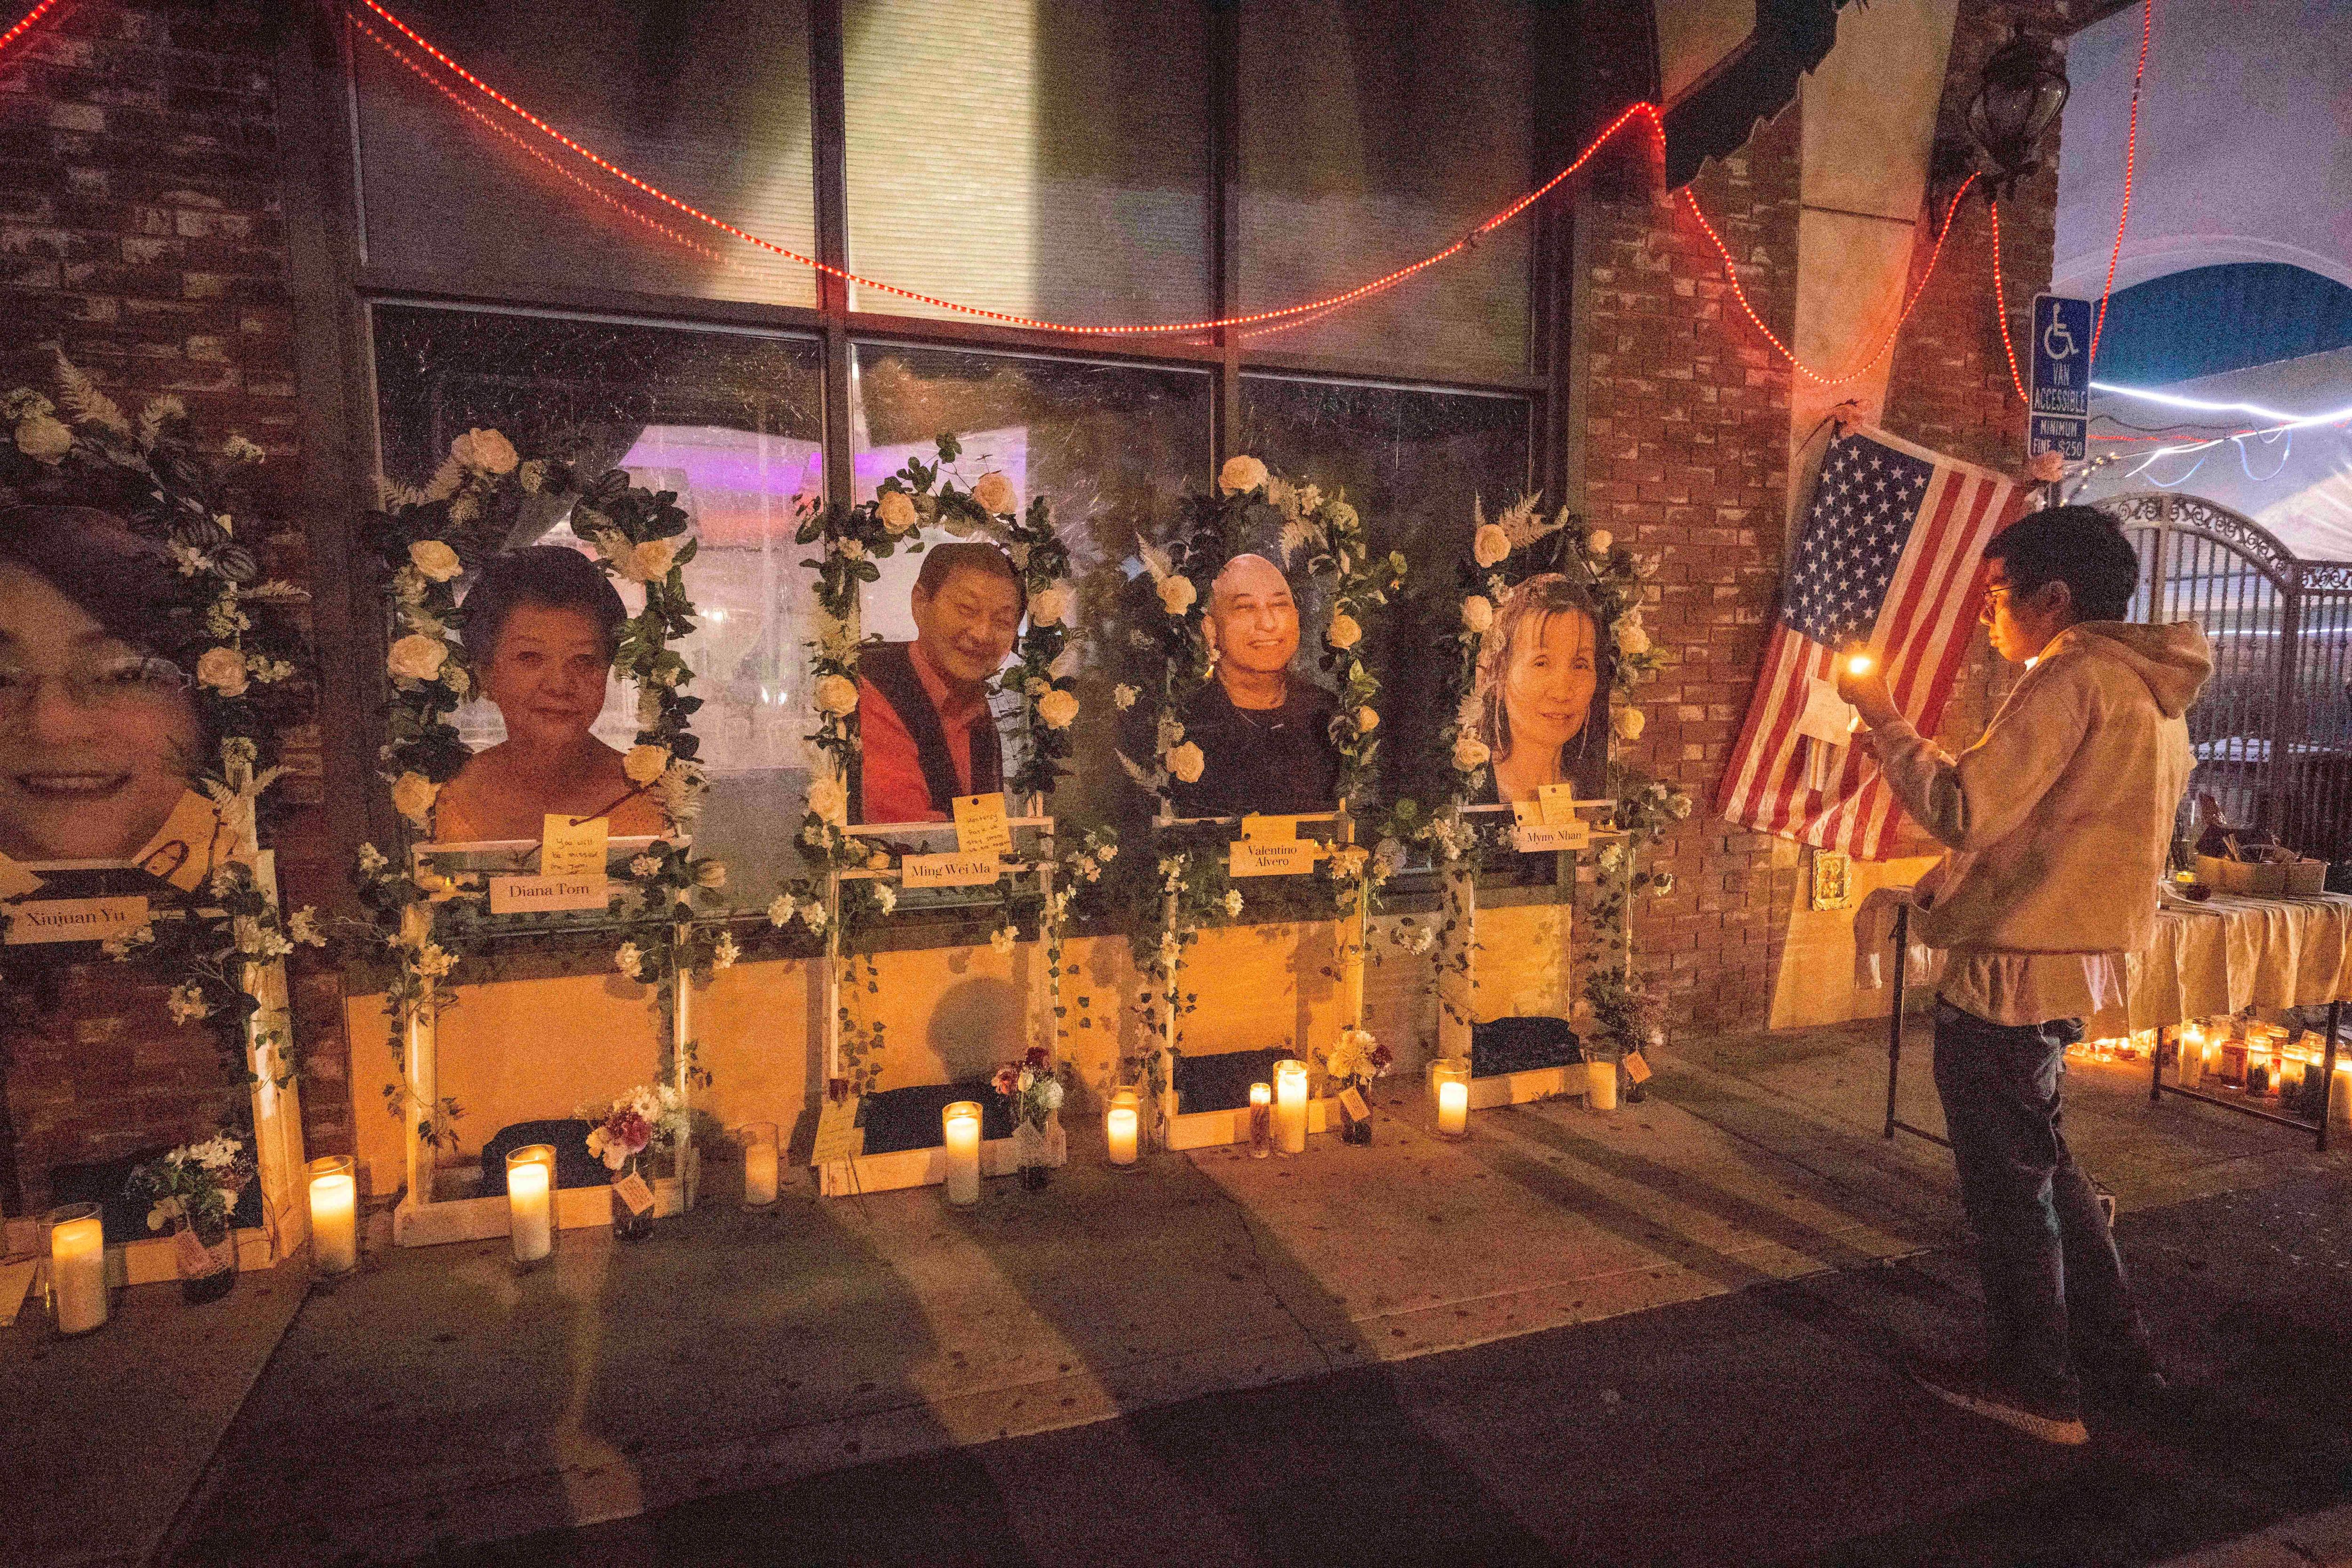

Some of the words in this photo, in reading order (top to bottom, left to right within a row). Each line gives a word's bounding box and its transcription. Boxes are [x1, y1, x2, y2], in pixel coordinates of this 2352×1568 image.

[2053, 363, 2070, 386] VAN
[2034, 387, 2086, 413] ACCESSIBLE
[2040, 420, 2077, 437] MINIMUM
[2033, 438, 2051, 454] FINE
[2058, 440, 2083, 457] $250
[1527, 832, 1554, 845] Mymy
[1557, 830, 1581, 841] Nhan
[1248, 845, 1297, 856] Valentino
[911, 866, 943, 879] Ming
[945, 863, 969, 875] Wei
[971, 862, 991, 874] Ma
[1255, 857, 1289, 867] Alvero
[509, 885, 552, 898] Diana
[556, 882, 589, 895] Tom
[26, 911, 97, 928] Xiujuan
[100, 908, 126, 922] Yu
